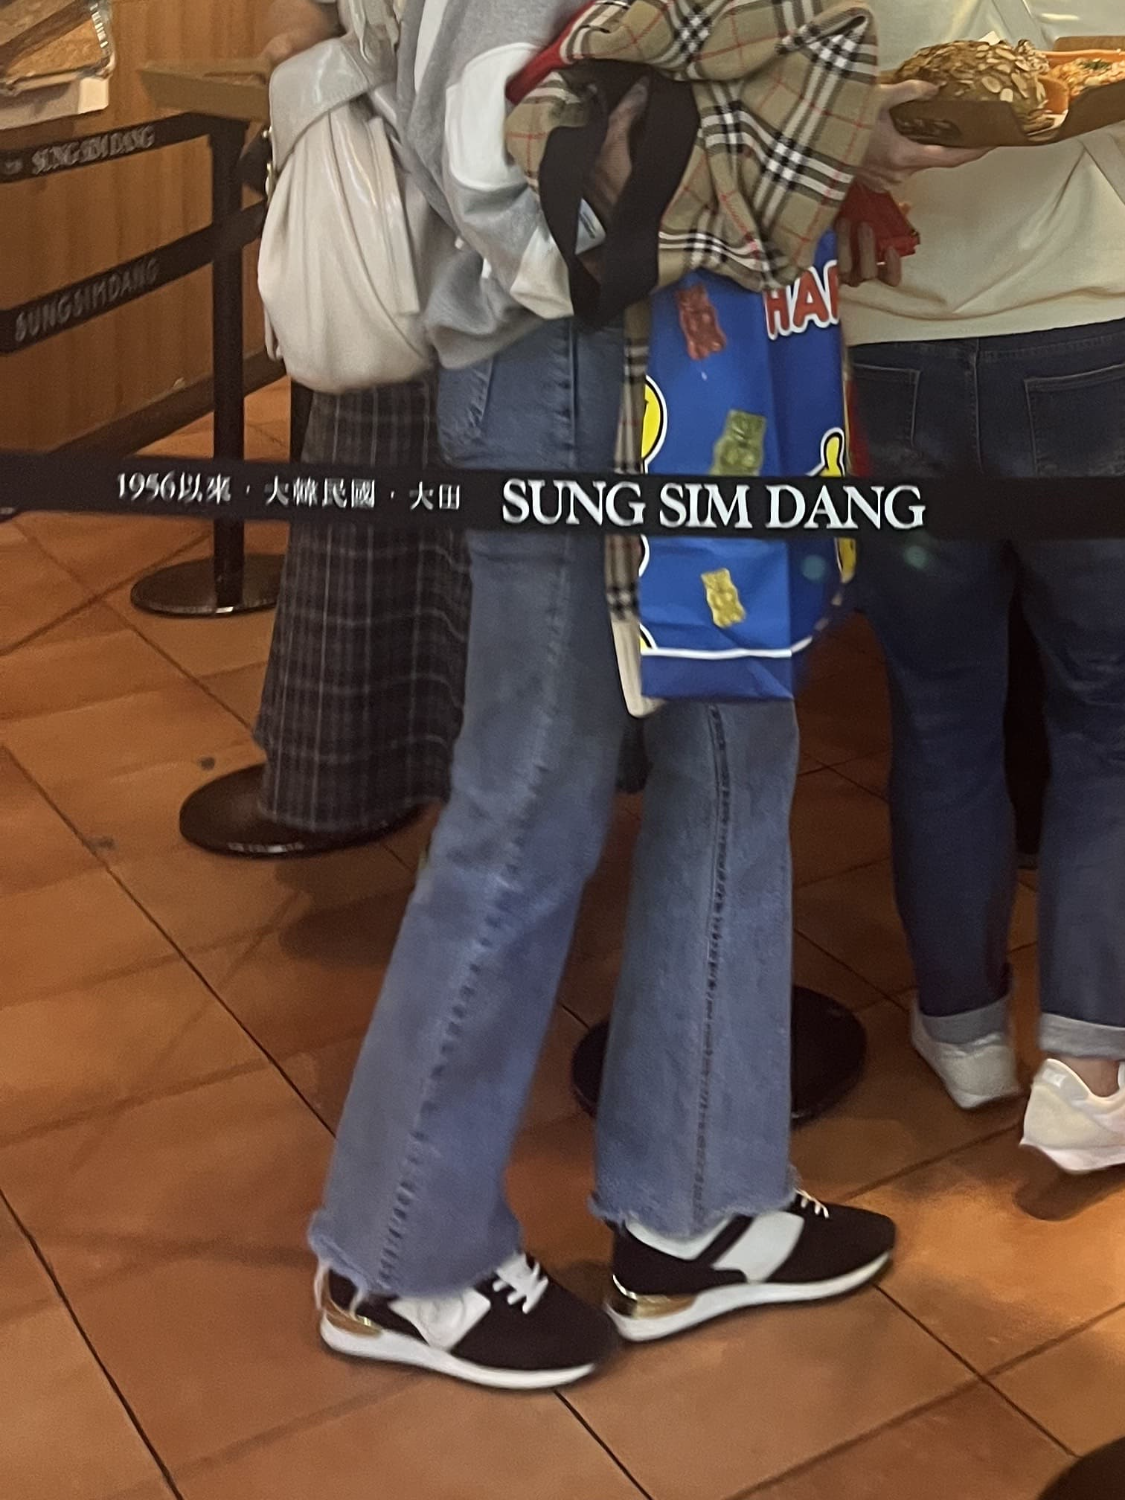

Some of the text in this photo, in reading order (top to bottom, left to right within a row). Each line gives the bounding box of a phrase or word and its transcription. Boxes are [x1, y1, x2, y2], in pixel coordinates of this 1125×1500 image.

[408, 480, 461, 511] 大田
[502, 477, 927, 531] SUNG SIM DANG
